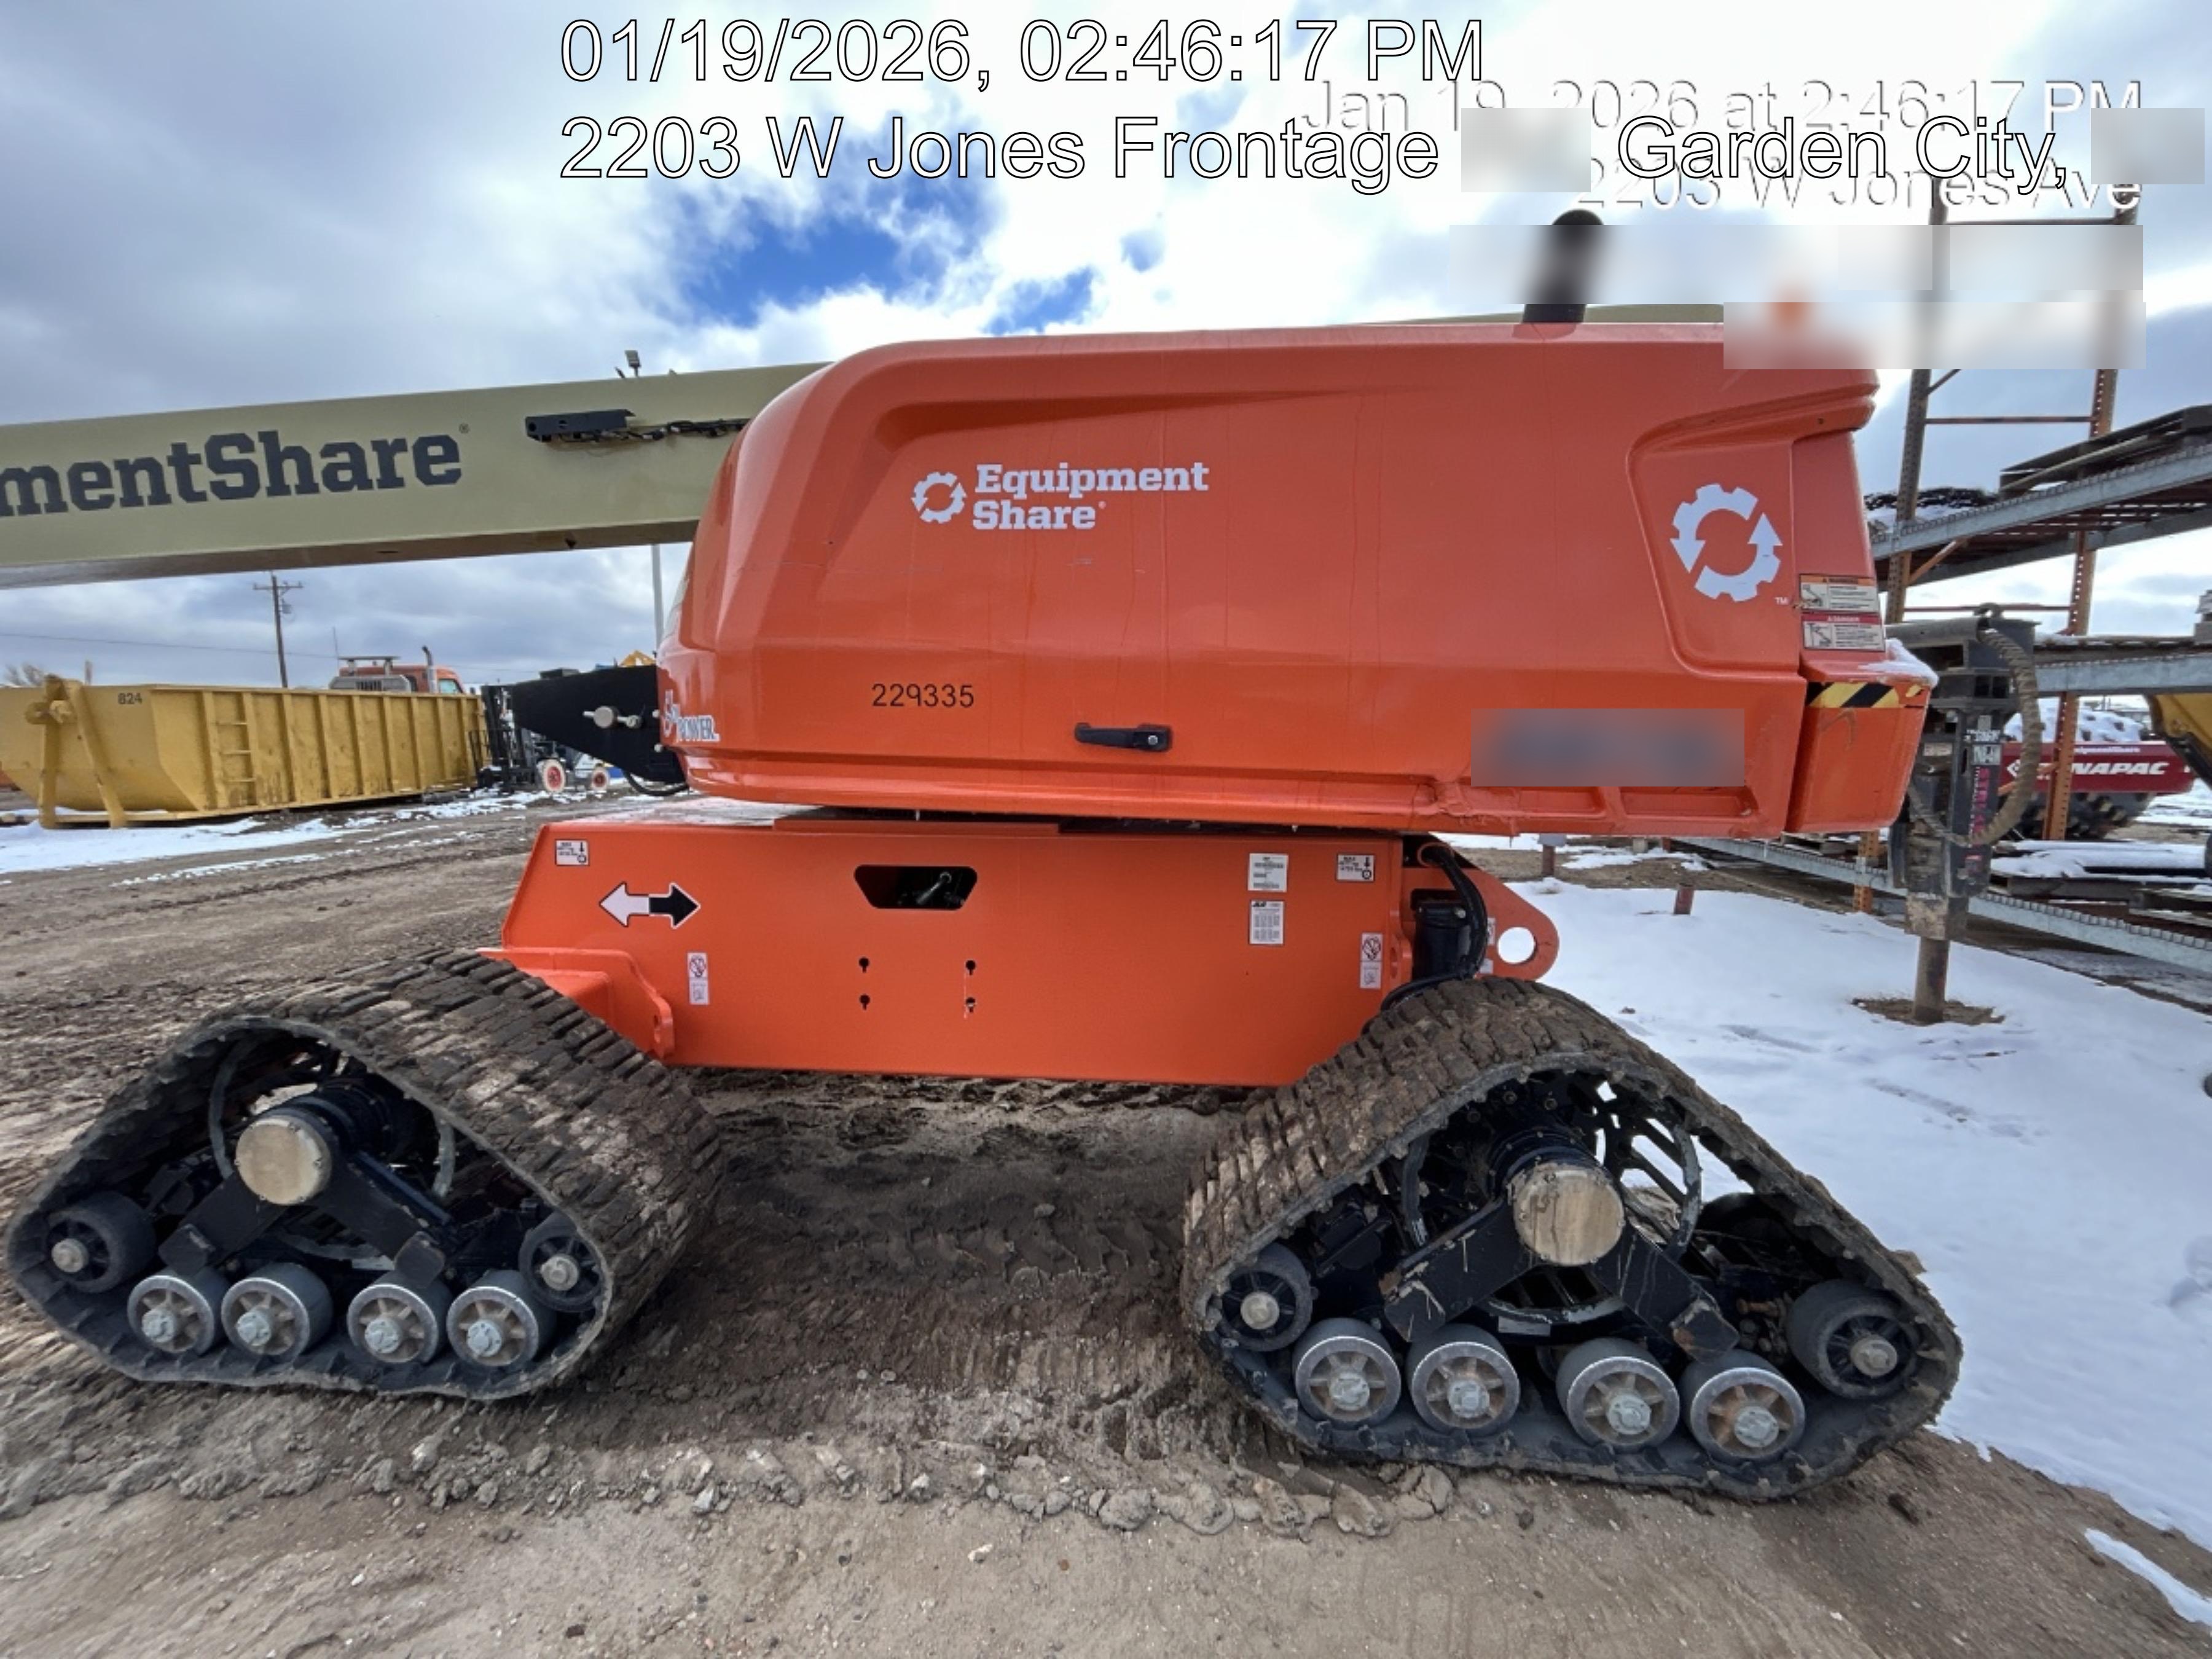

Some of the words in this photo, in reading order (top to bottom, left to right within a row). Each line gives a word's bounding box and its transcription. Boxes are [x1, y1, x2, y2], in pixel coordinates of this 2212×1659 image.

[975, 462, 1209, 498] Equipment
[973, 500, 1096, 530] Share
[117, 692, 143, 705] 824
[871, 683, 975, 707] 229335
